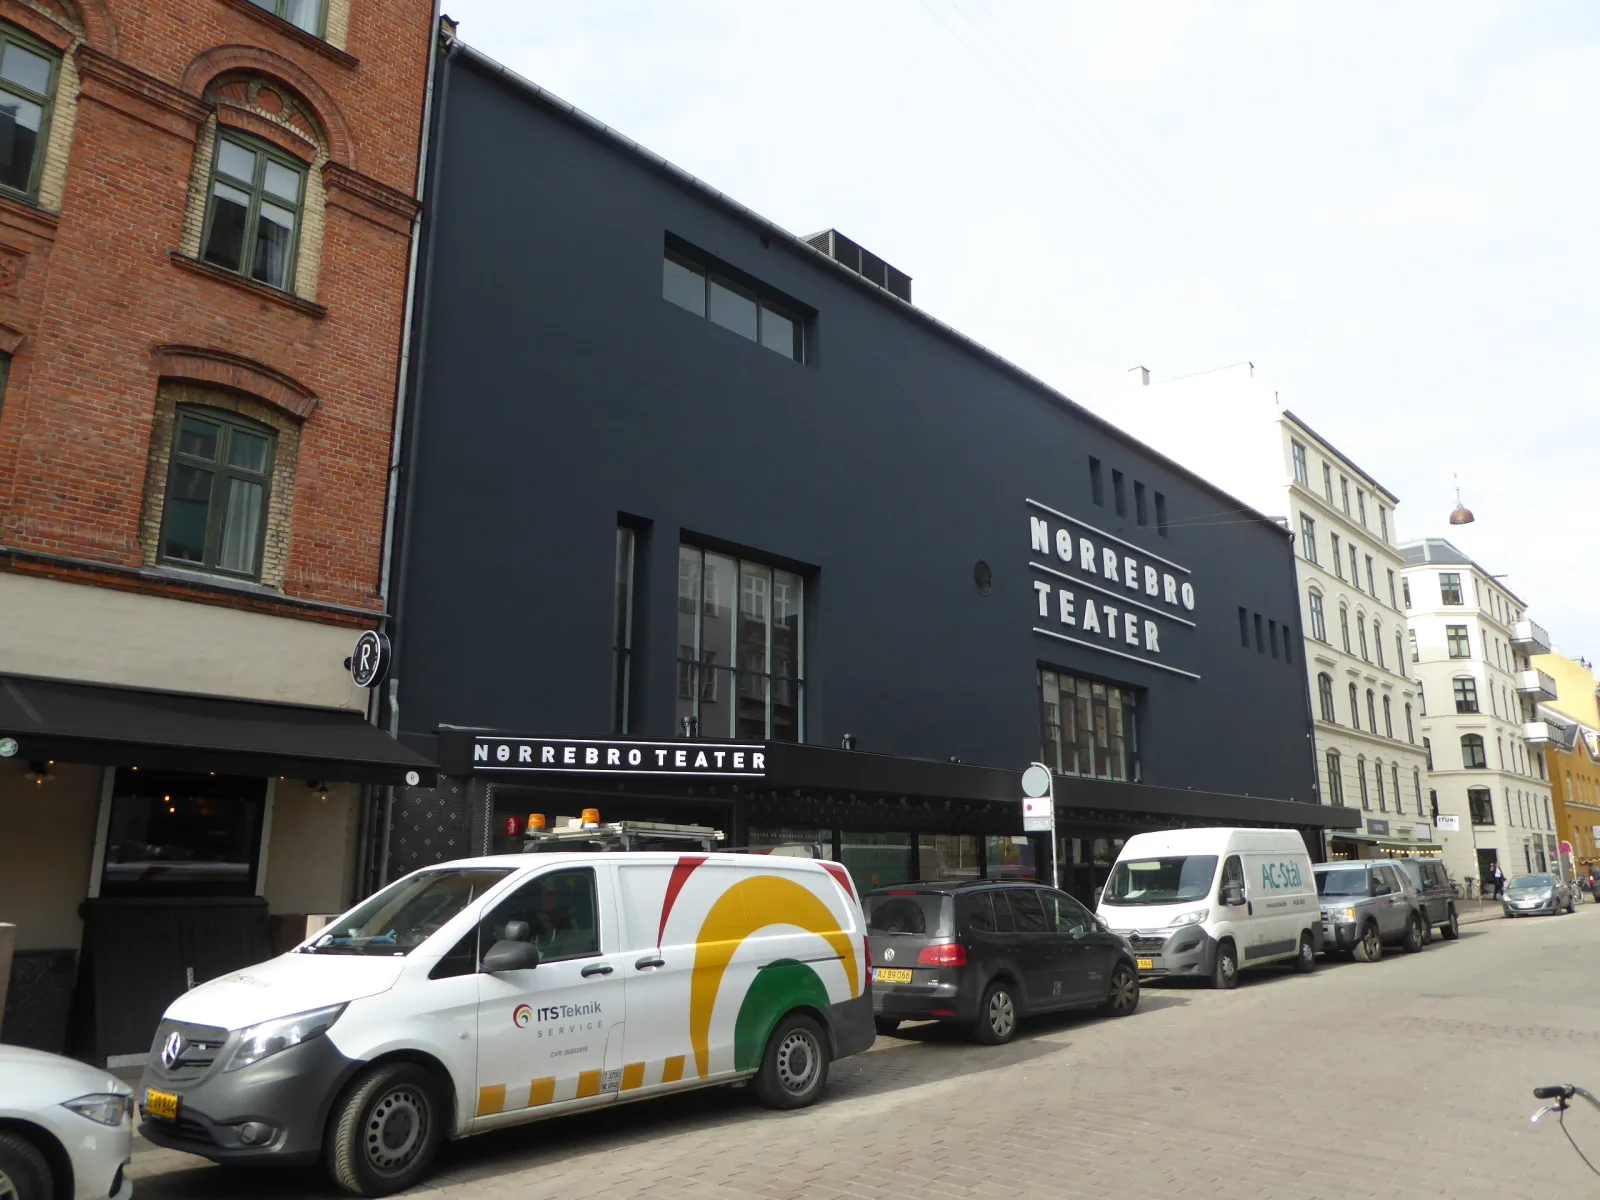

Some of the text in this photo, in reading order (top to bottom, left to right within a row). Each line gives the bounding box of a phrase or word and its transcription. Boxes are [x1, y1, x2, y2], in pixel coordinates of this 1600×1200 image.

[1034, 580, 1160, 652] TEATER
[360, 644, 371, 671] R
[655, 749, 765, 769] TEATER
[1262, 860, 1302, 889] AC-Stål
[537, 1020, 603, 1038] SERVICE
